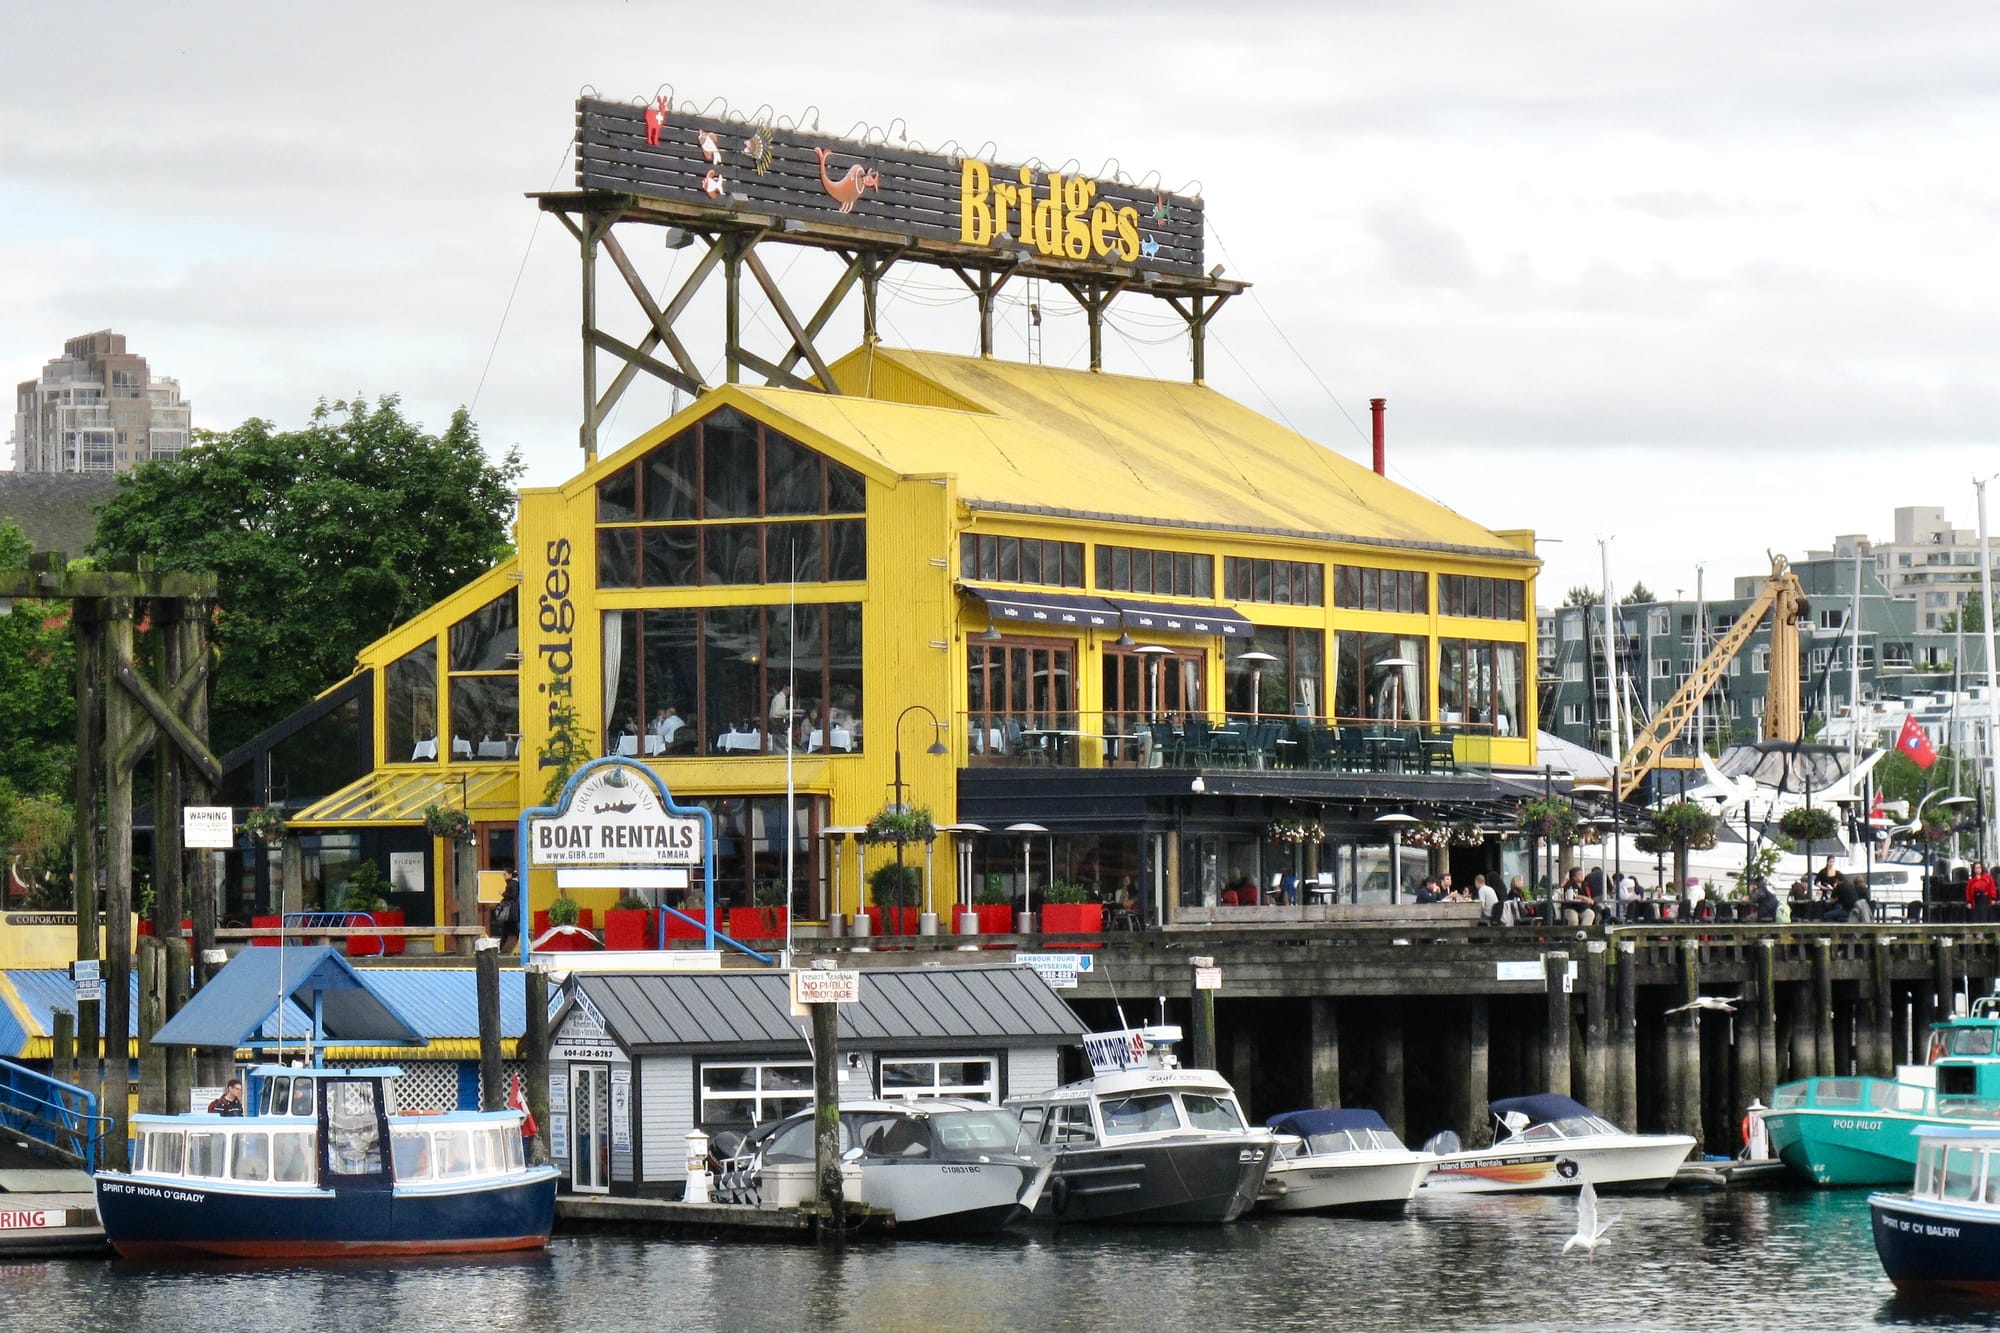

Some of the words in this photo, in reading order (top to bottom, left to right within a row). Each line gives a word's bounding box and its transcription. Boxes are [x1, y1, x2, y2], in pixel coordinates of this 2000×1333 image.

[960, 158, 1140, 262] Bridges
[190, 811, 227, 821] WARNING
[540, 825, 593, 849] BOAT
[601, 825, 693, 849] RENTALS
[546, 850, 605, 860] www.GIBR.com
[657, 850, 689, 859] YAMAHA
[16, 915, 65, 924] CORPORATE
[804, 981, 818, 990] NO
[820, 981, 853, 990] PUBLIC
[1565, 975, 1571, 991] A
[586, 1002, 605, 1030] RENTALS
[1084, 1039, 1108, 1067] BOAT
[1103, 1036, 1131, 1065] TOURS
[1833, 1119, 1853, 1129] POD
[1856, 1120, 1882, 1130] PILOT
[1440, 1162, 1459, 1170] Island
[1478, 1159, 1503, 1168] Rentals
[102, 1183, 124, 1193] SPIRIT
[125, 1186, 136, 1194] OF
[137, 1187, 162, 1198] NORA
[163, 1190, 205, 1203] O'GRADY
[0, 1211, 46, 1227] RING
[1900, 1221, 1911, 1232] OF
[1912, 1223, 1925, 1234] CY
